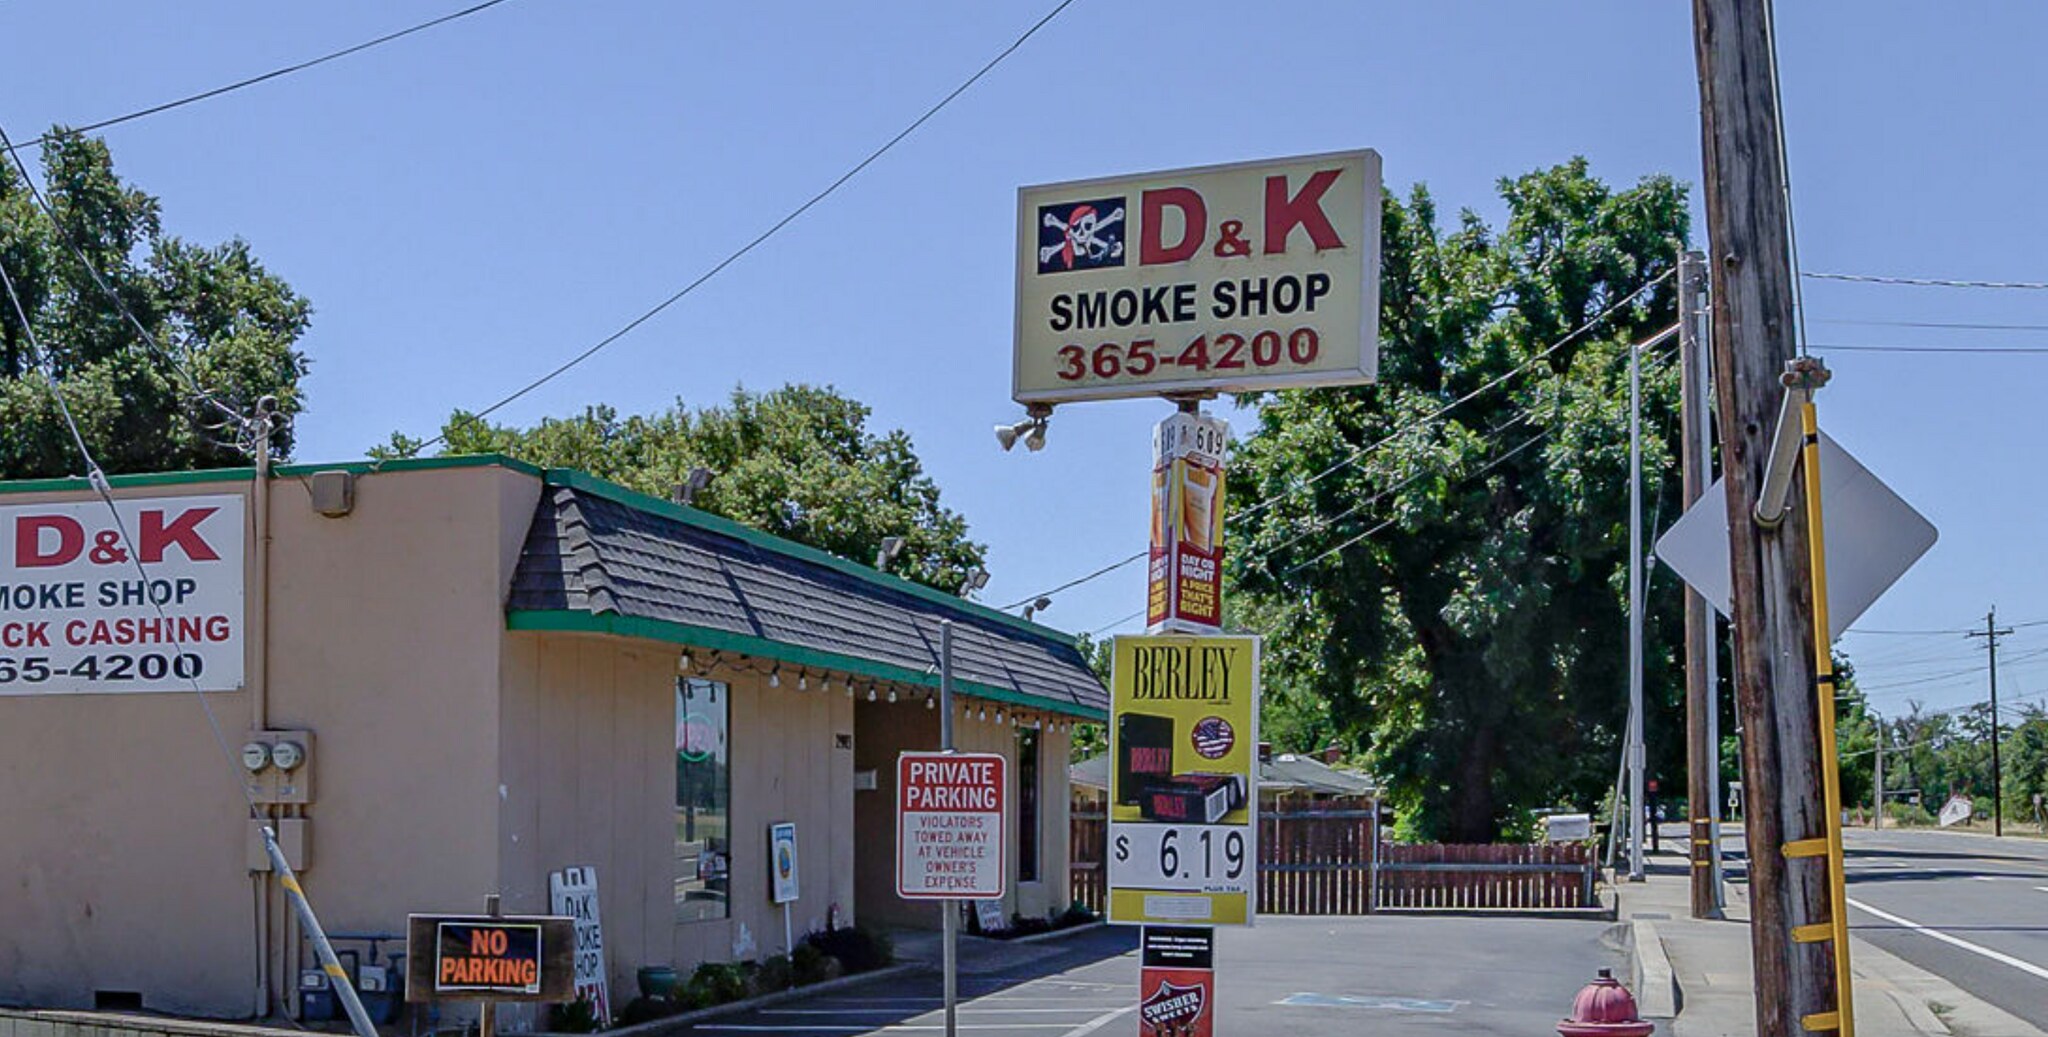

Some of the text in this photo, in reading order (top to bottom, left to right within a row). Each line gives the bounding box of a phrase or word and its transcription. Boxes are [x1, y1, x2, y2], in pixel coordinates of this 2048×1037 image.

[1139, 169, 1346, 266] D&K
[1050, 272, 1331, 332] SMOKE SHOP
[1057, 327, 1320, 381] 365-4200
[15, 507, 222, 568] D&K
[1180, 565, 1215, 582] NIGHT
[0, 578, 197, 611] OKE SHOP
[65, 616, 230, 647] CASHING
[0, 653, 203, 683] 65-4200
[1132, 646, 1238, 700] BERLEY
[910, 762, 995, 785] PRIVATE
[906, 786, 997, 809] PARKING
[920, 816, 984, 829] VIOLATORS
[914, 830, 988, 843] TOWED AWAY
[918, 846, 985, 858] AT VEHICLE
[1116, 829, 1245, 879] $ 6.19
[926, 861, 977, 873] OWNER'S
[924, 875, 978, 888] EXPENSE
[471, 929, 508, 955] NO
[441, 956, 537, 985] PARKING
[1144, 992, 1199, 1017] SWISHER
